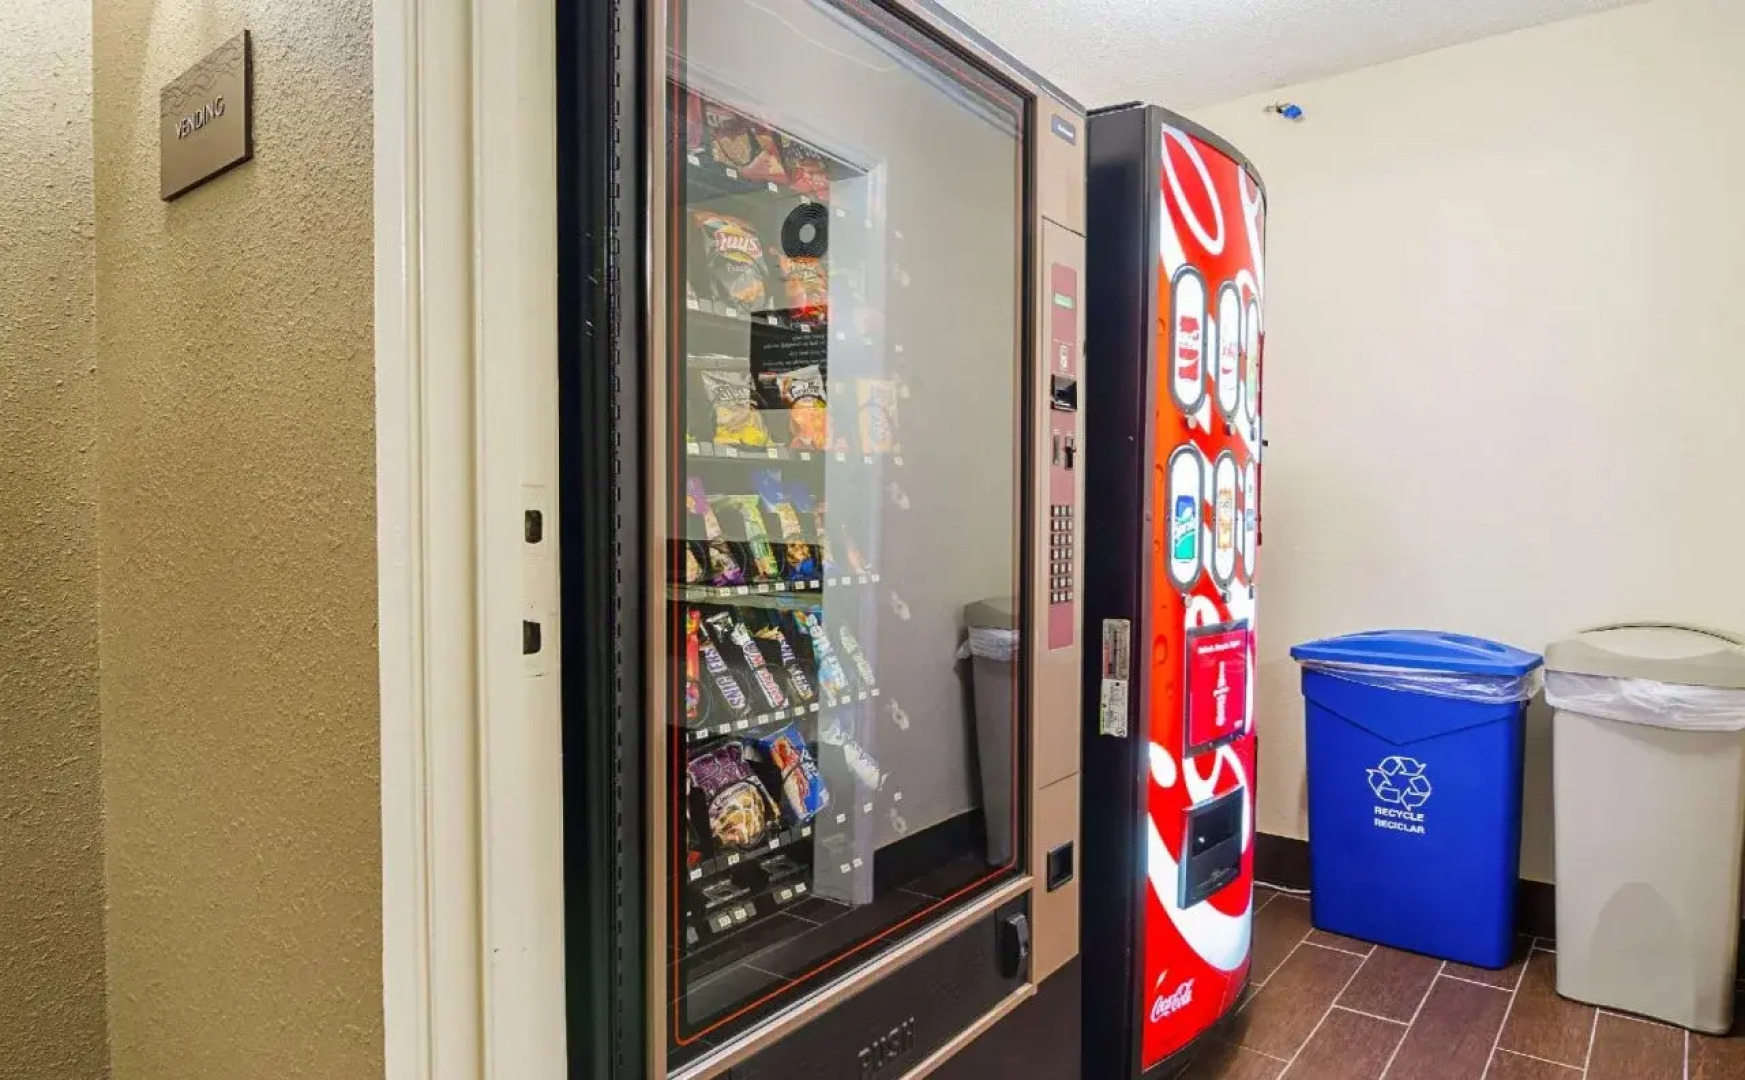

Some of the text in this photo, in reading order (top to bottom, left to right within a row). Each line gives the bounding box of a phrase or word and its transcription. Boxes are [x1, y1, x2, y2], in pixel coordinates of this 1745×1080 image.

[176, 95, 226, 140] VENDING
[1373, 805, 1425, 822] RECYCLE
[1373, 817, 1425, 834] RECICLAR
